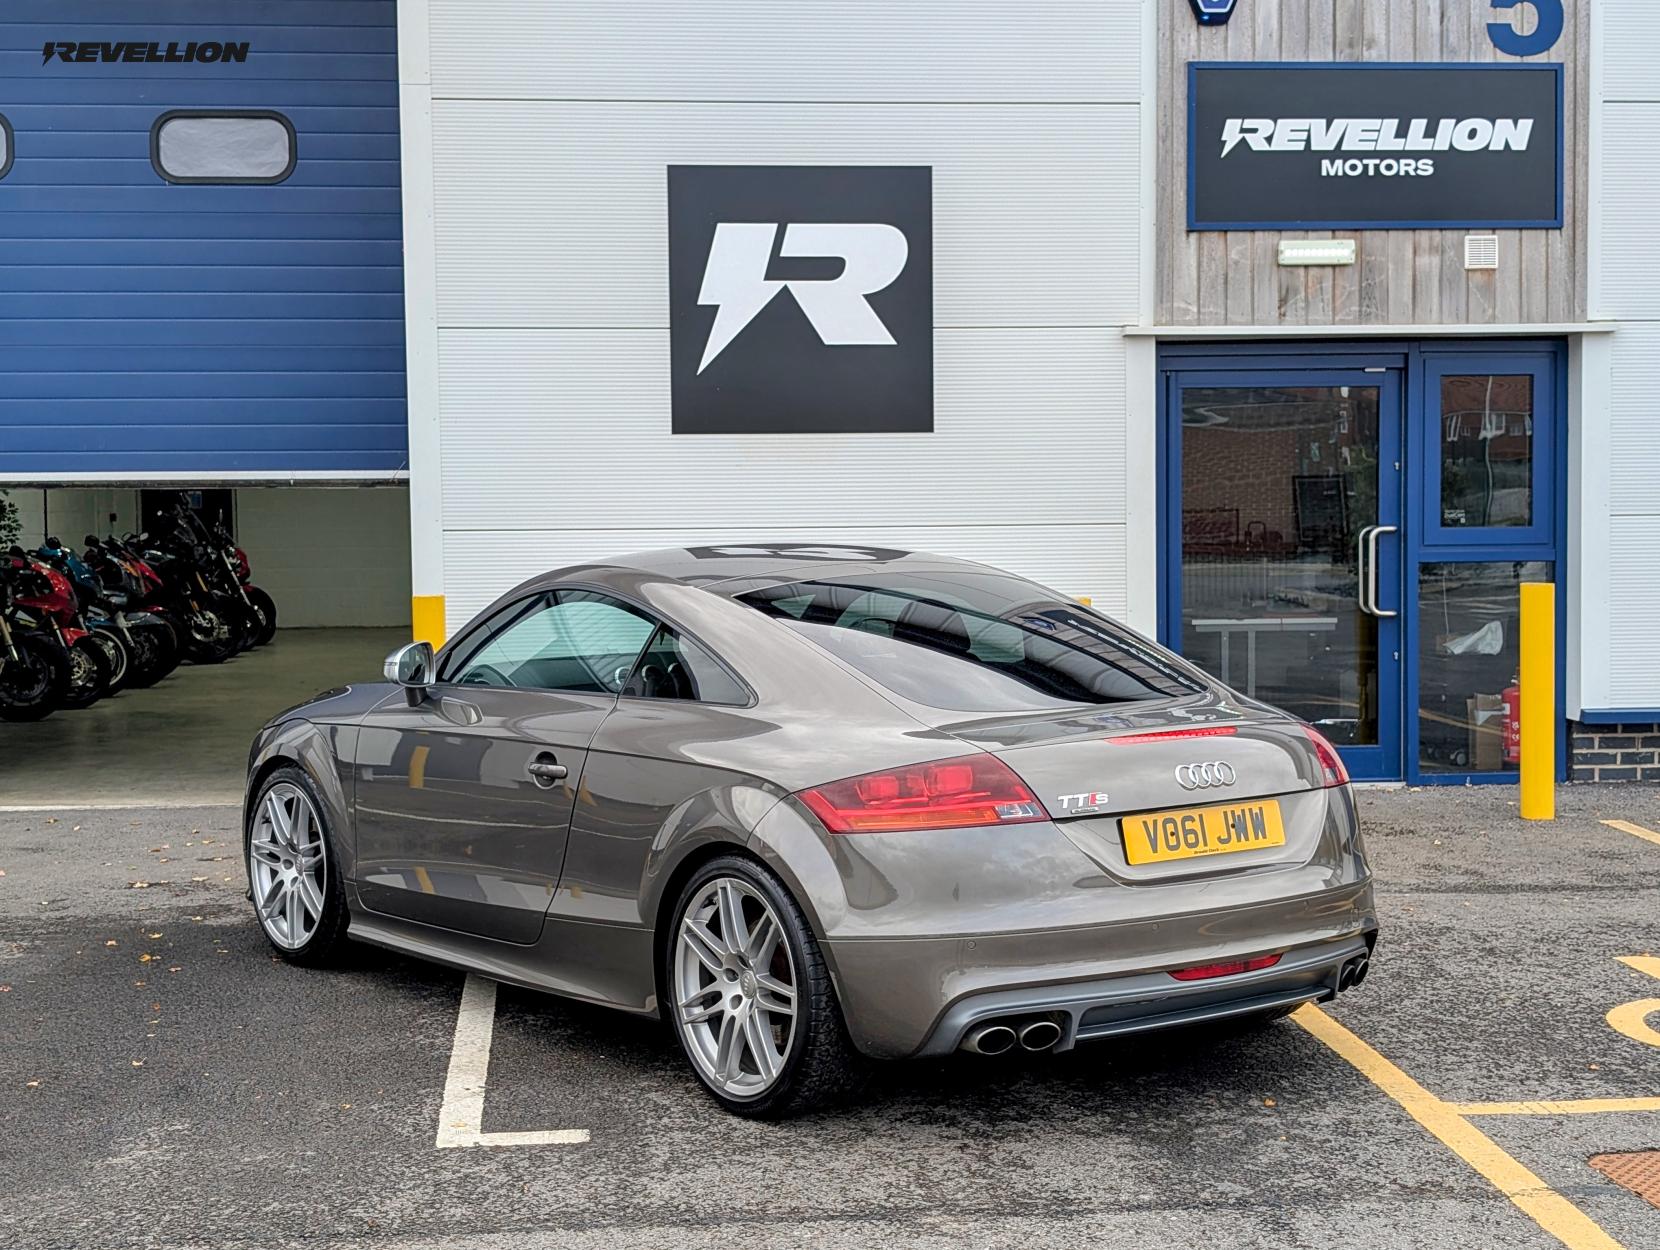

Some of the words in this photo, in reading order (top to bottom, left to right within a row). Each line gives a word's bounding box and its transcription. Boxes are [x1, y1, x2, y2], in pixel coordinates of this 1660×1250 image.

[1221, 117, 1535, 159] REVELLION
[1321, 158, 1435, 177] MOTORS
[697, 222, 909, 376] R
[1057, 791, 1110, 809] TTS
[1142, 813, 1209, 854] VO61
[1216, 806, 1268, 845] JWW
